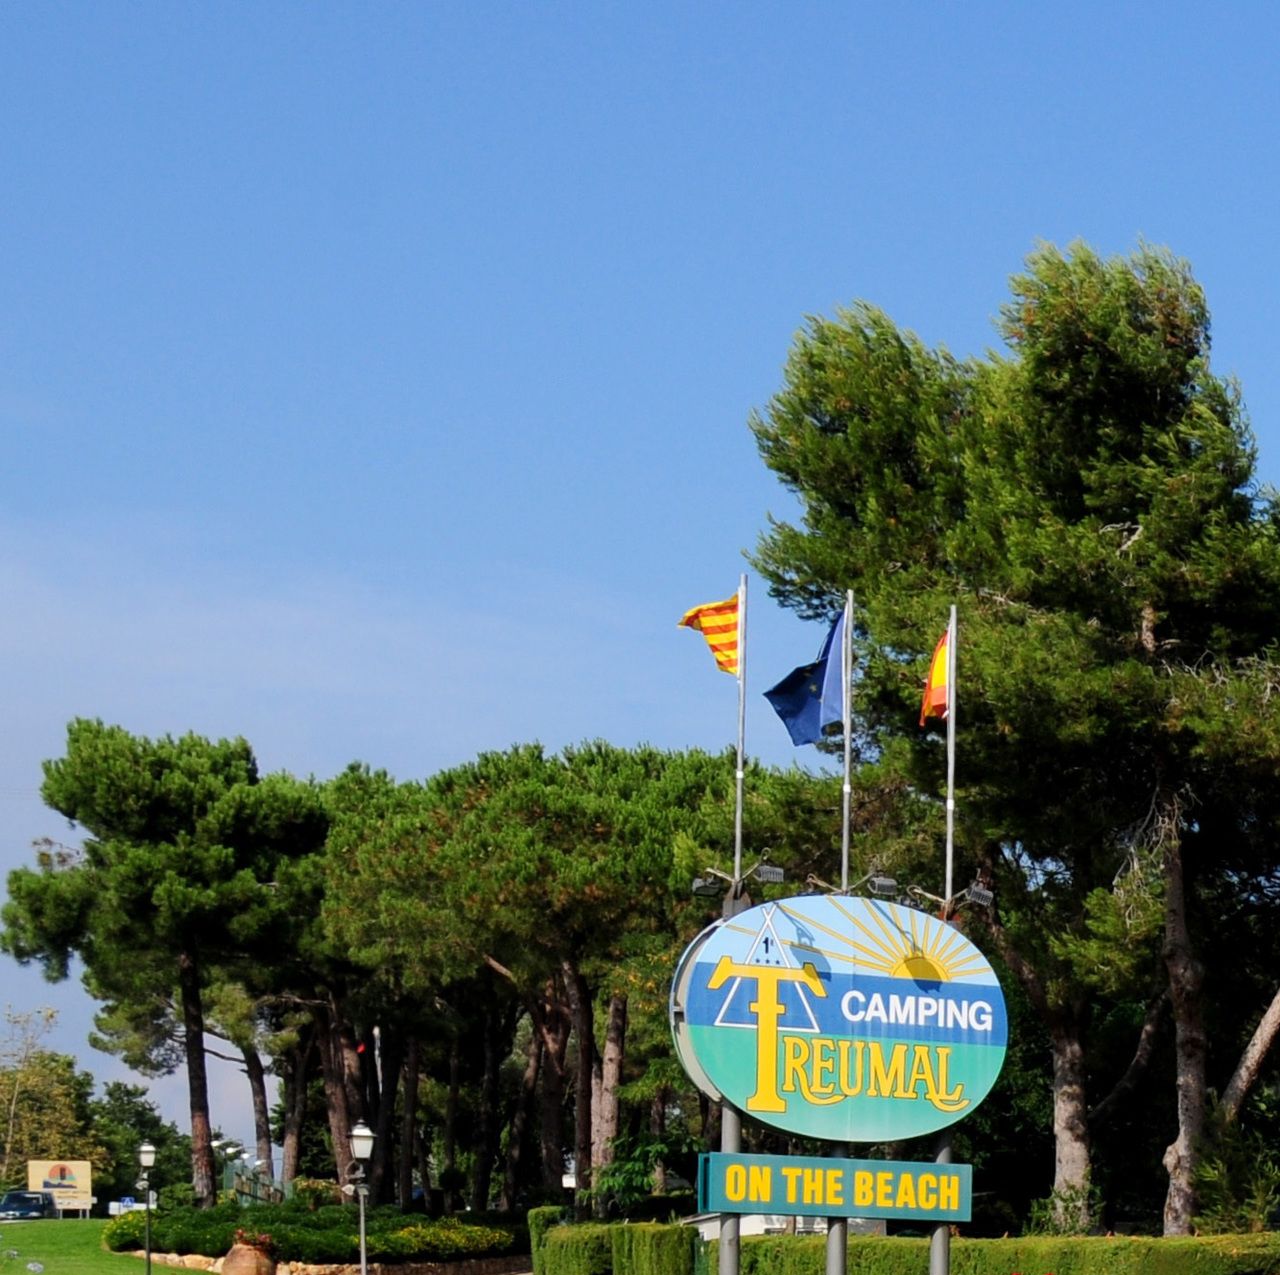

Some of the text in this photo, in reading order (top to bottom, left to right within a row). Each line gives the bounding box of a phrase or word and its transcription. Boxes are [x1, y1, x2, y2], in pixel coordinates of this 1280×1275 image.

[841, 990, 993, 1031] CAMPING
[707, 955, 970, 1113] TREUMAL
[725, 1164, 960, 1210] ON THE BEACH
